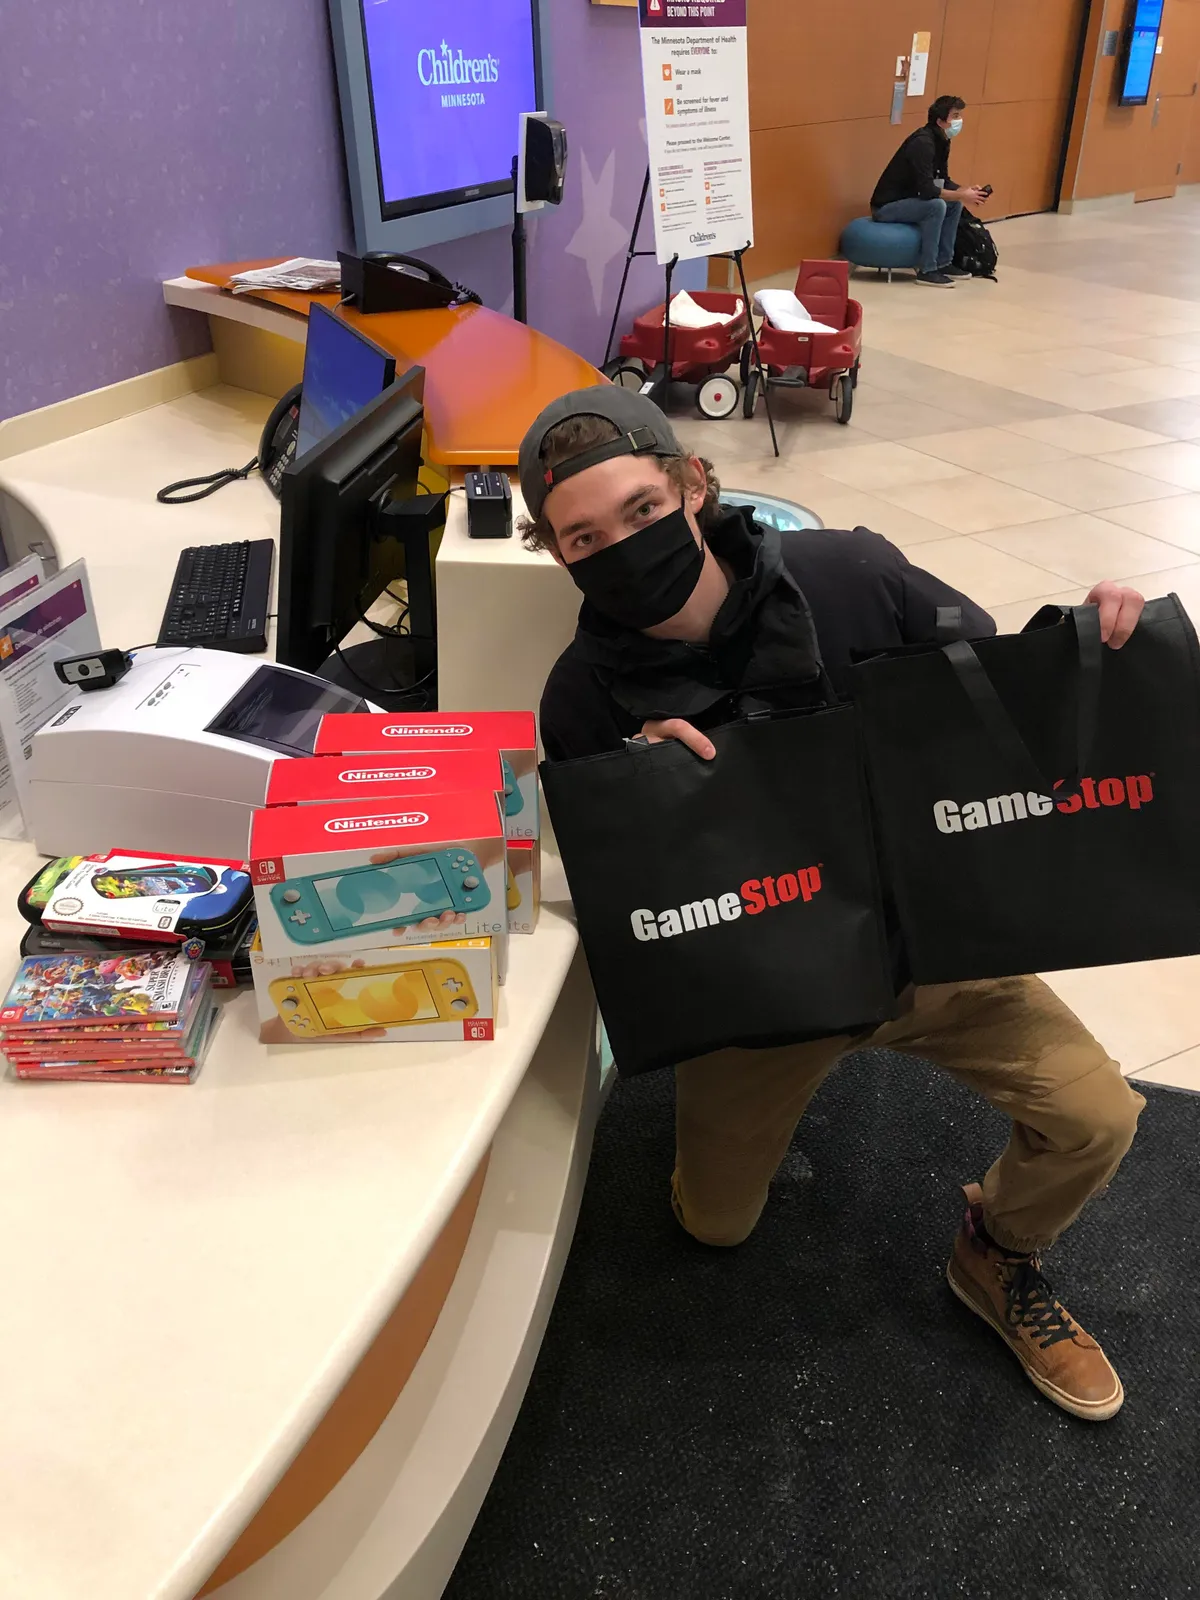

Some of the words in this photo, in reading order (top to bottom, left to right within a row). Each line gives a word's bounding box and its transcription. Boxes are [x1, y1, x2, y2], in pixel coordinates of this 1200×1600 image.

[667, 6, 687, 17] BEYOND
[688, 6, 699, 17] THIS
[700, 6, 715, 17] POINT
[651, 36, 660, 45] The
[661, 36, 685, 45] Minnesota
[686, 36, 714, 46] Department
[721, 35, 737, 43] Health
[671, 48, 690, 57] requires
[417, 47, 499, 86] Children's
[441, 92, 485, 108] MINNESOTA
[390, 726, 466, 735] Nintendo
[347, 769, 428, 780] Nintendo
[334, 815, 420, 829] Nintendo
[510, 825, 533, 837] ite
[630, 866, 822, 942] GameStop
[465, 921, 502, 936] Lite
[509, 920, 530, 931] ite
